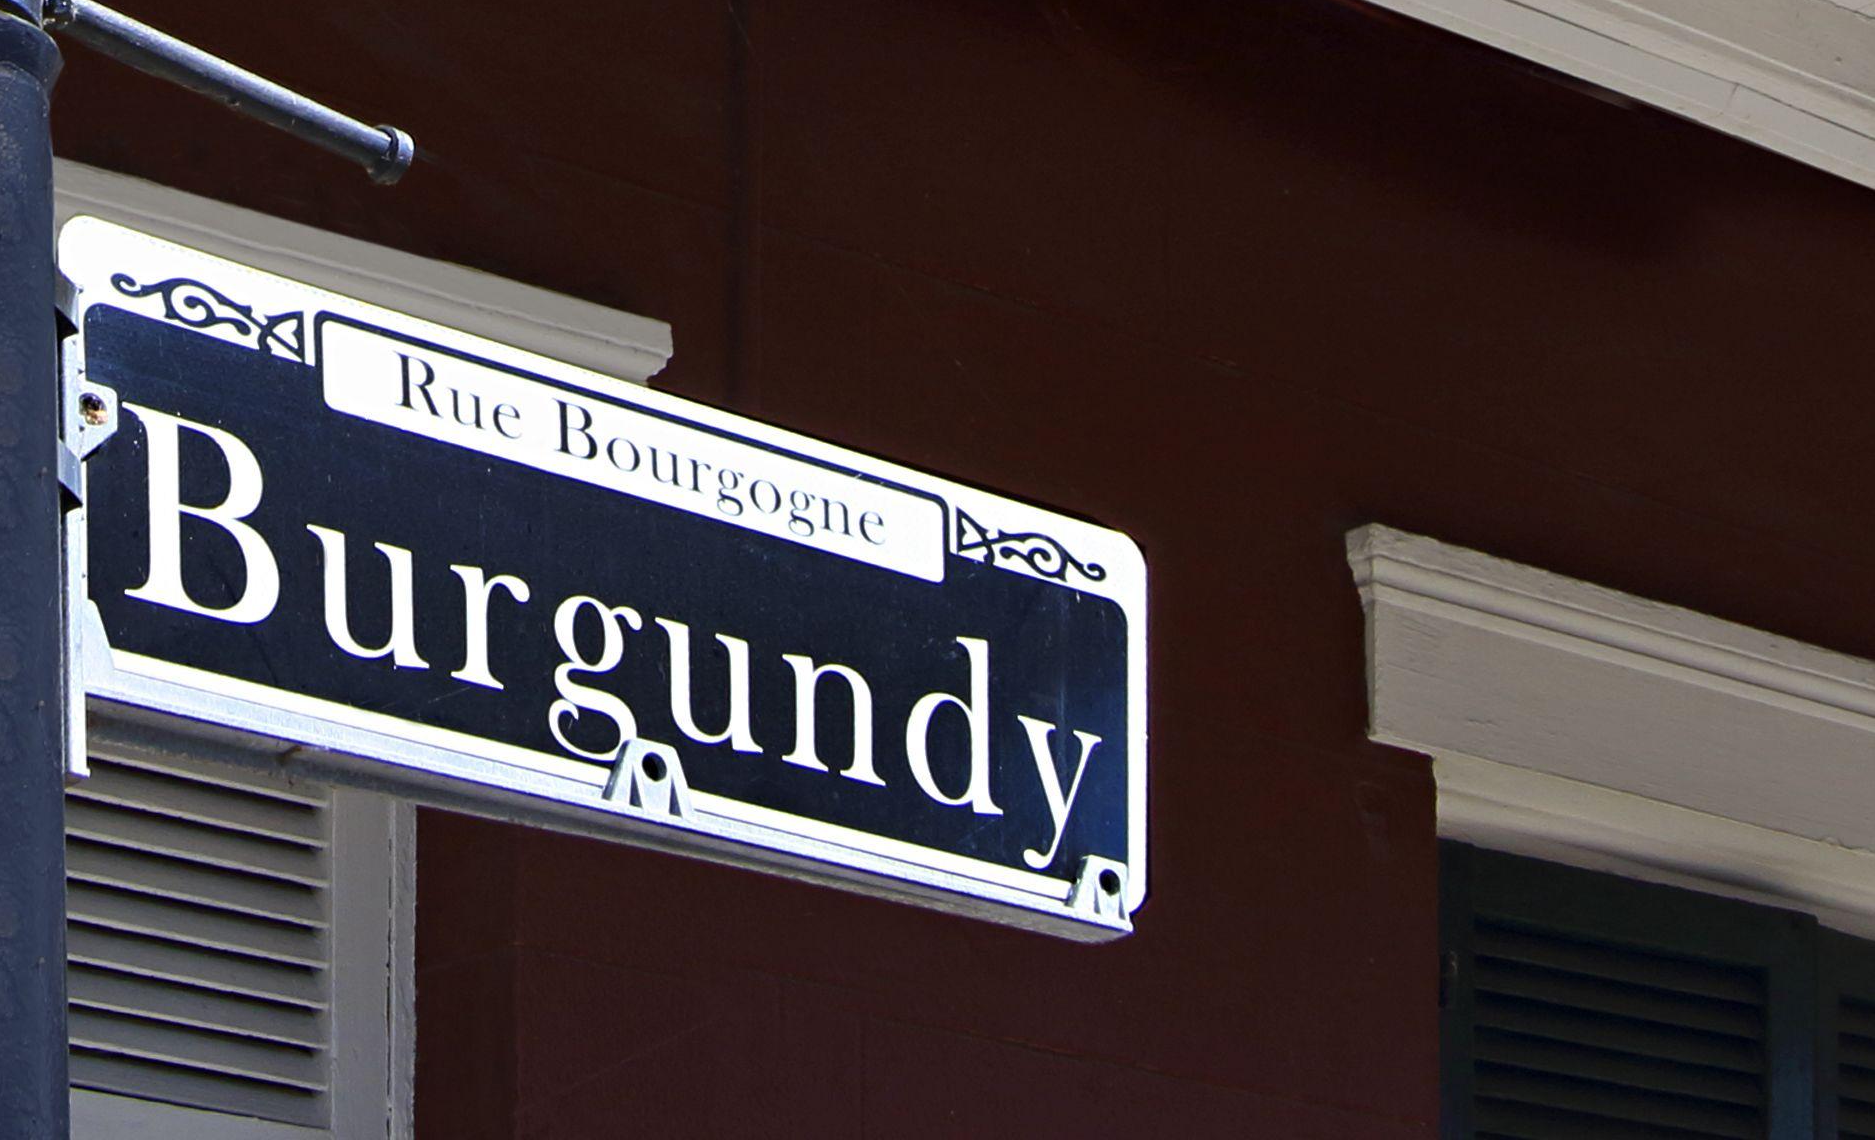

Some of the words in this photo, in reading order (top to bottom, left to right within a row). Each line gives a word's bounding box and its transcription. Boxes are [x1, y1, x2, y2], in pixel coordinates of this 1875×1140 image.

[393, 350, 523, 440] Rue
[553, 397, 887, 547] Bourgogne
[121, 400, 1103, 870] Burgundy
